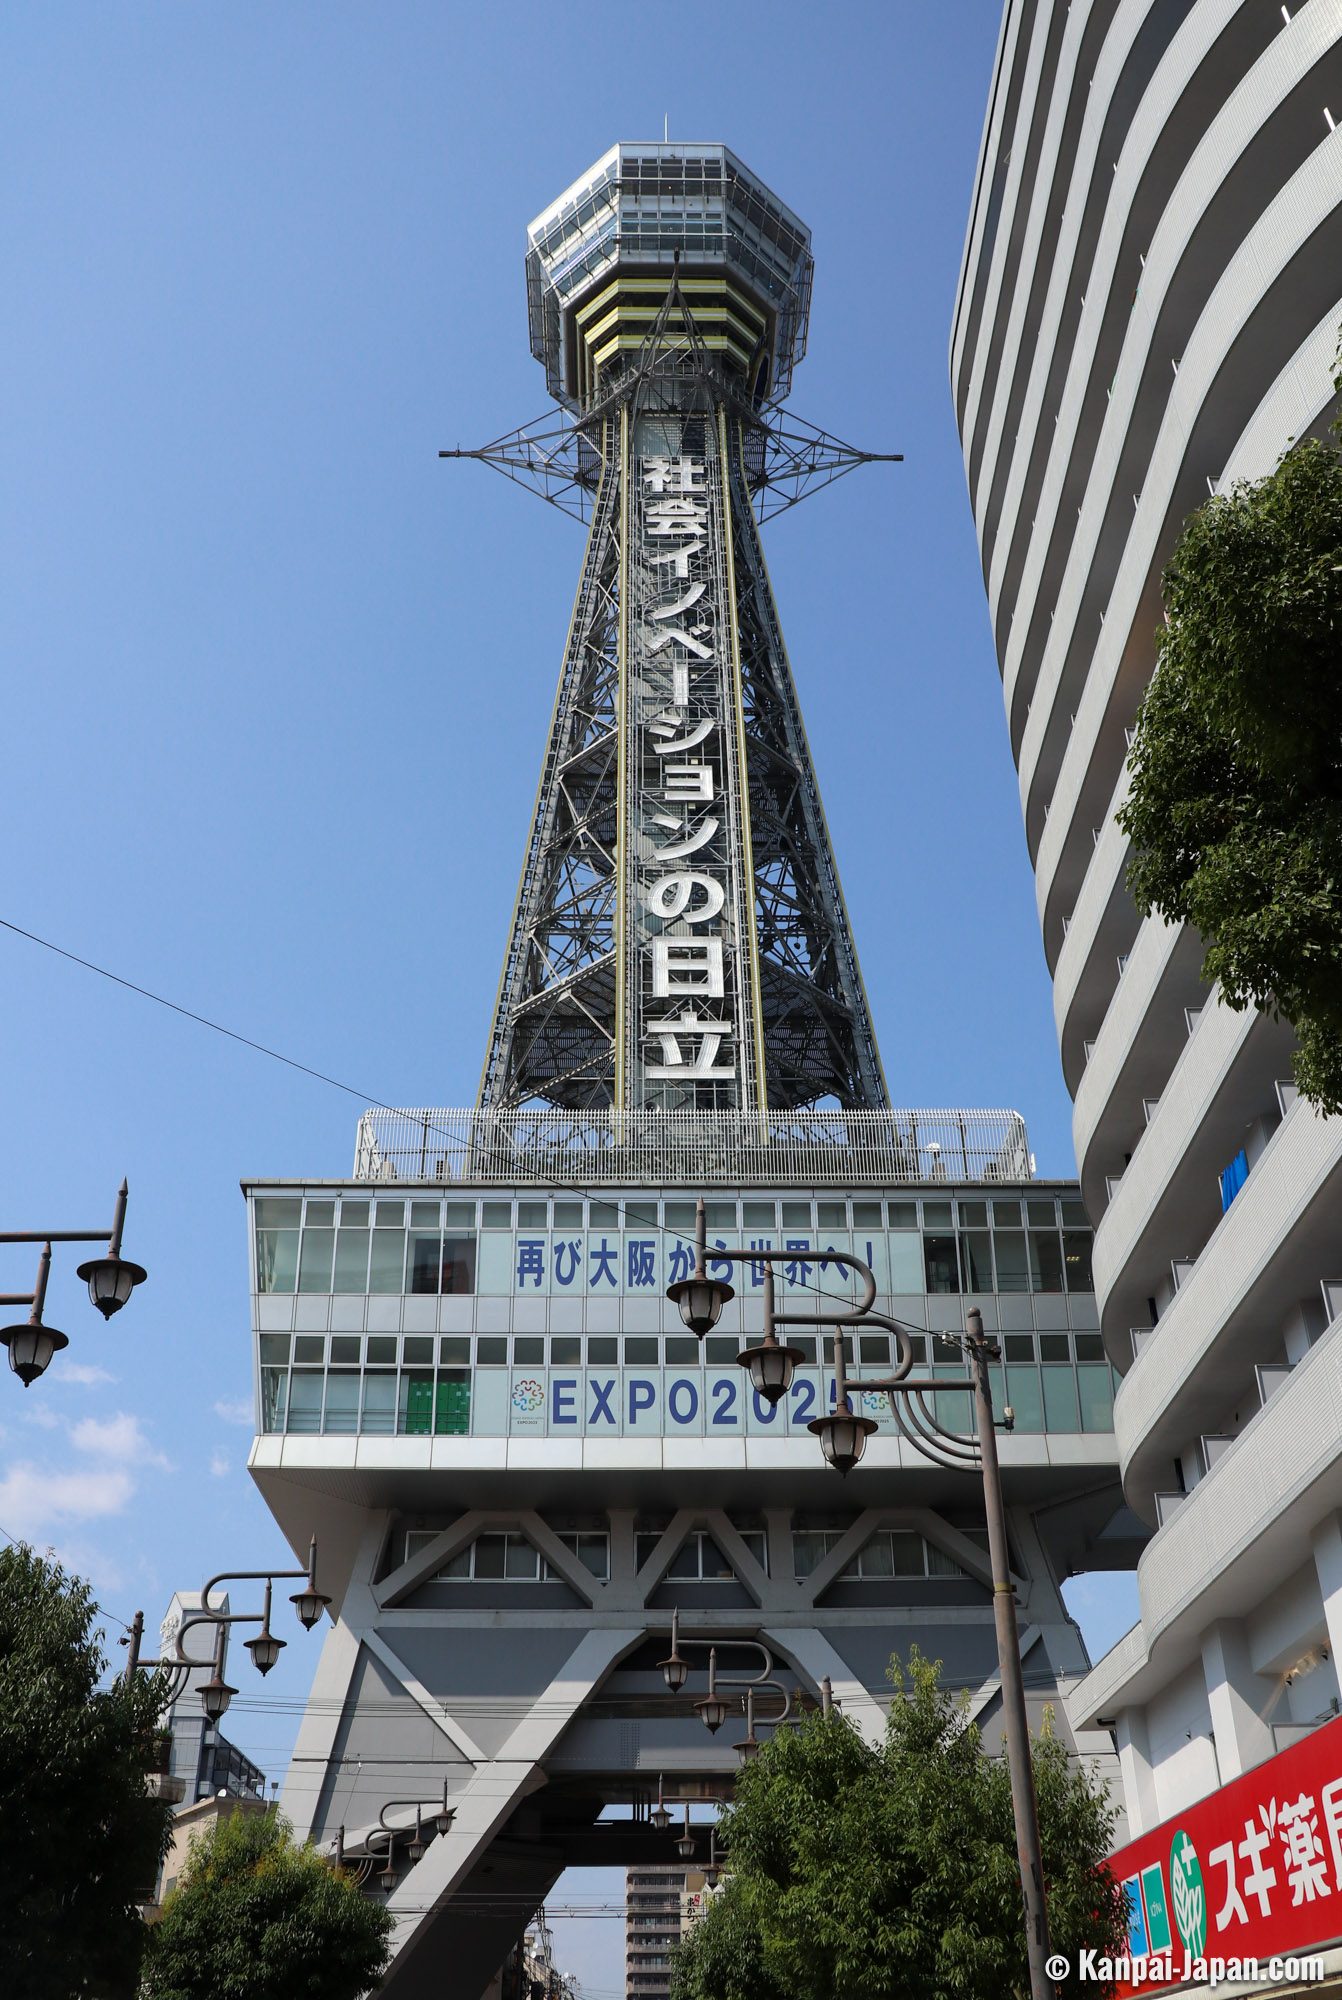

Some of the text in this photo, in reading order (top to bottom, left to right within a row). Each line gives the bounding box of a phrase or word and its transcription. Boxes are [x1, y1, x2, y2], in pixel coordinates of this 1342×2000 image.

[643, 457, 736, 1079] 社会イノベーションの日立
